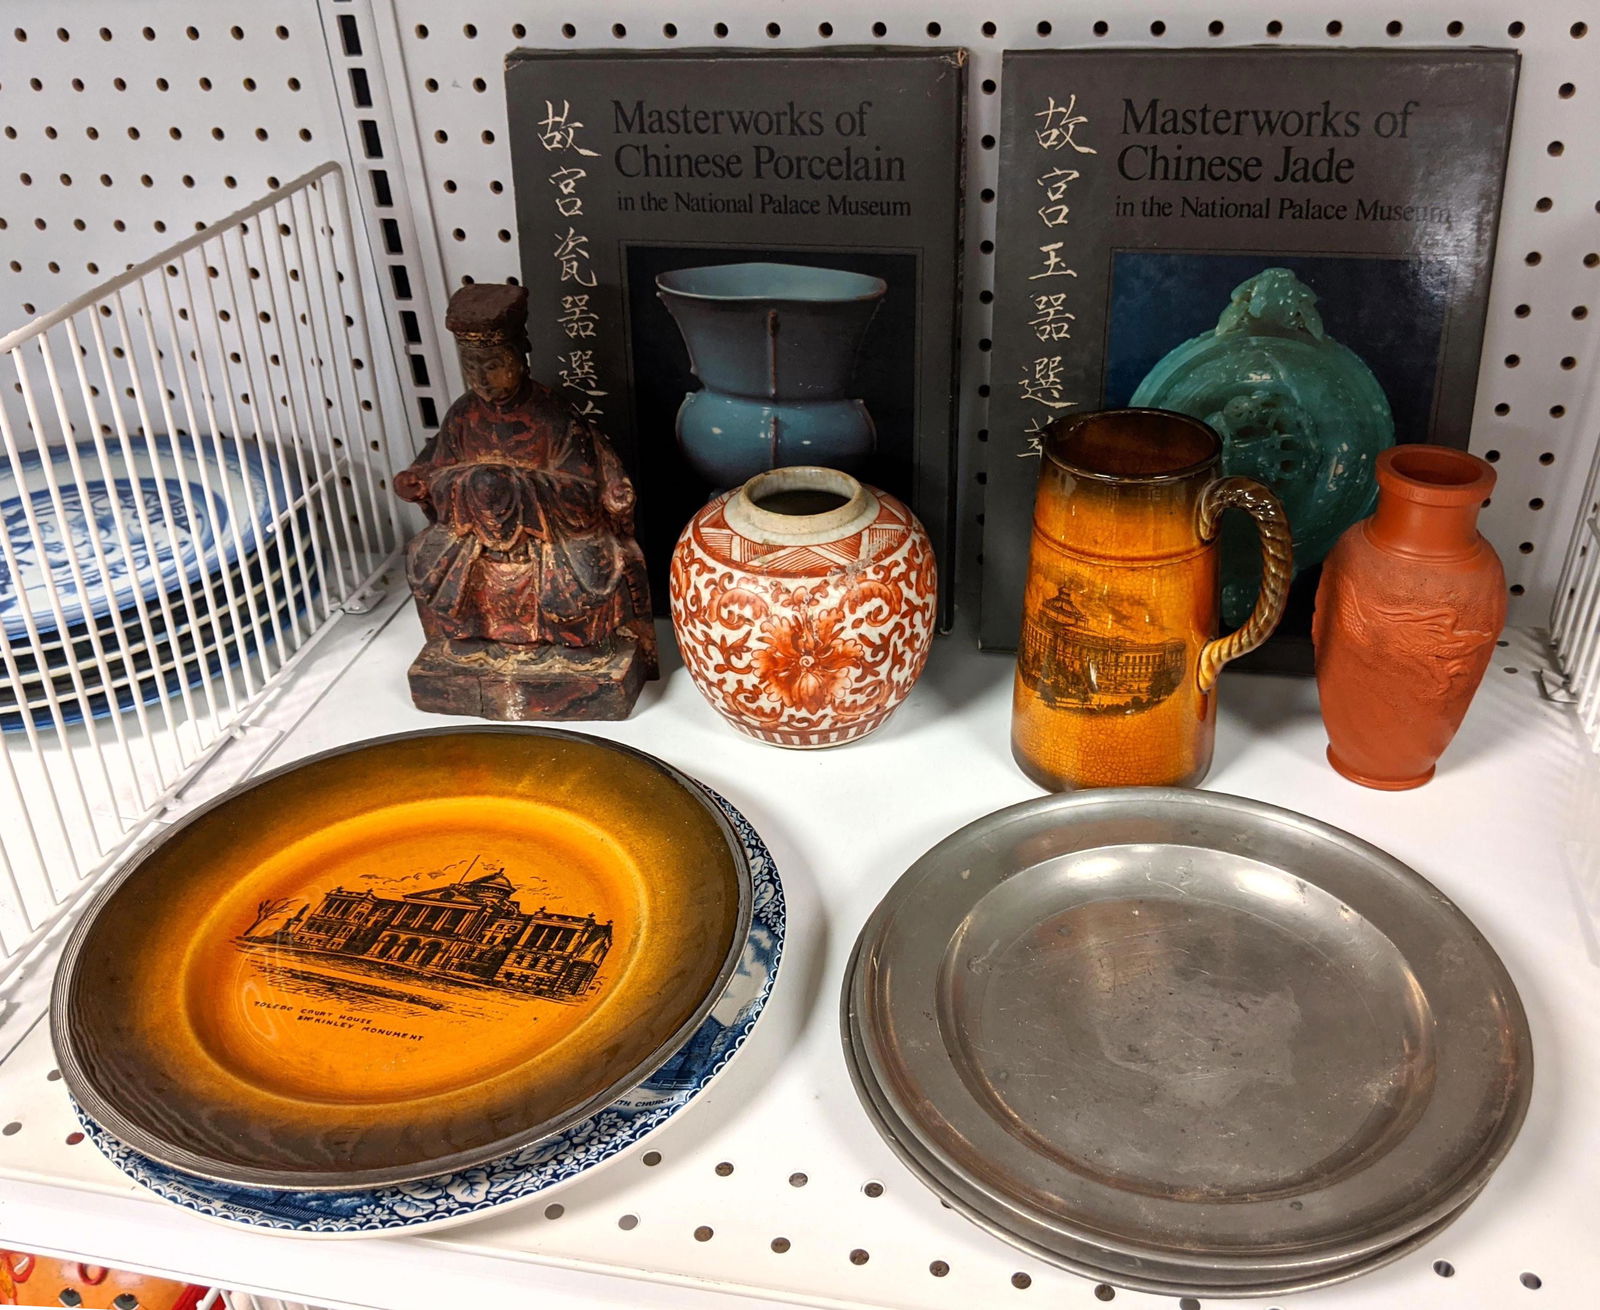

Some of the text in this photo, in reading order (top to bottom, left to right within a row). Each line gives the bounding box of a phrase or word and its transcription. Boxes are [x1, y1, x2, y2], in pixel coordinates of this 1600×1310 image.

[612, 100, 873, 137] Masterworks of
[1121, 98, 1420, 139] Masterworks of
[615, 143, 906, 182] Chinese Porcelain
[1117, 144, 1355, 184] Chinese Jade
[617, 191, 912, 217] in the National Palace Museum
[1115, 196, 1451, 222] in the National Palace Museum
[254, 1001, 373, 1024] TOLEDO COURT HOUSE
[361, 1026, 424, 1041] MONUMENT
[635, 1097, 674, 1107] CHURCH
[220, 1203, 259, 1216] SQUARE
